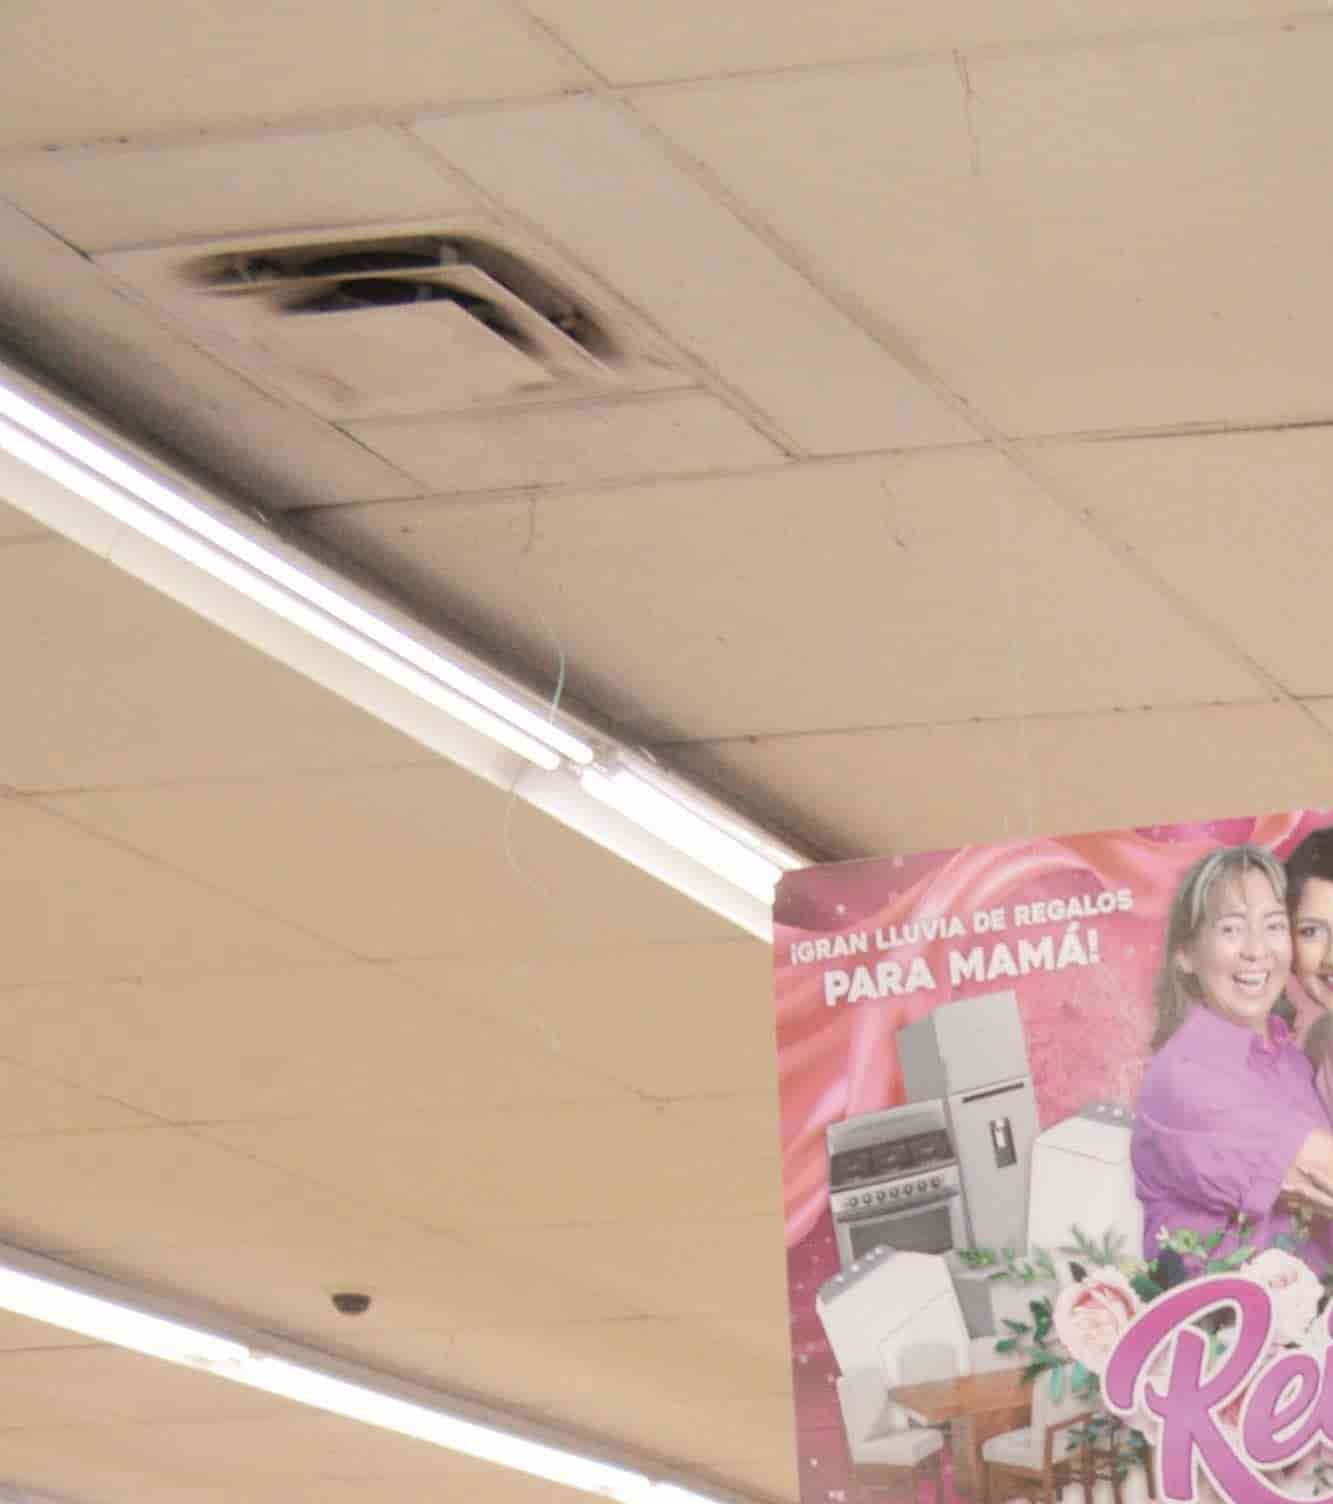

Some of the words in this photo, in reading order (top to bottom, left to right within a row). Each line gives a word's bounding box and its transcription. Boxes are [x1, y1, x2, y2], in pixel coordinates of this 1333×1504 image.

[790, 932, 868, 966] ¡GRAN
[876, 915, 966, 949] LLUVIA
[972, 907, 1006, 934] DE
[1014, 888, 1133, 927] REGALOS
[824, 956, 935, 1007] PARA
[950, 921, 1100, 987] MAMÁ!
